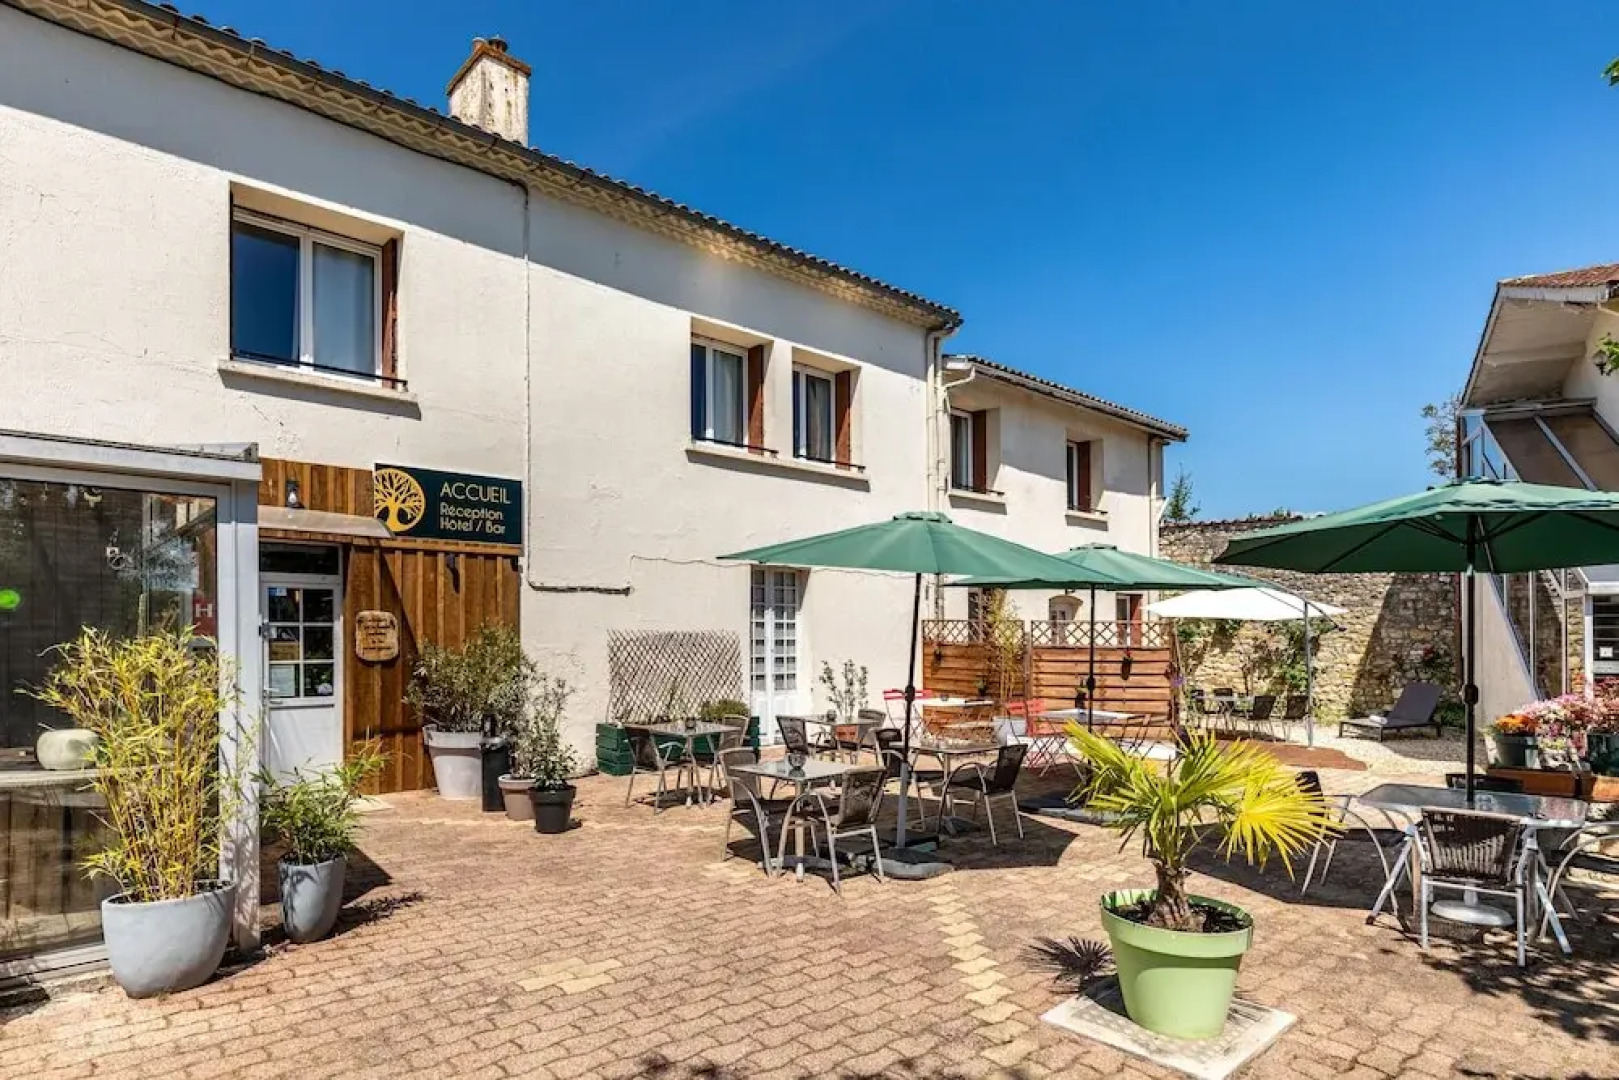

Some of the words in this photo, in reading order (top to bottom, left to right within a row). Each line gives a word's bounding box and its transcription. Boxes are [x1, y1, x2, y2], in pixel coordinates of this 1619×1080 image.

[440, 481, 511, 504] ACCUEIL
[485, 521, 506, 535] Bar
[195, 603, 213, 618] H
